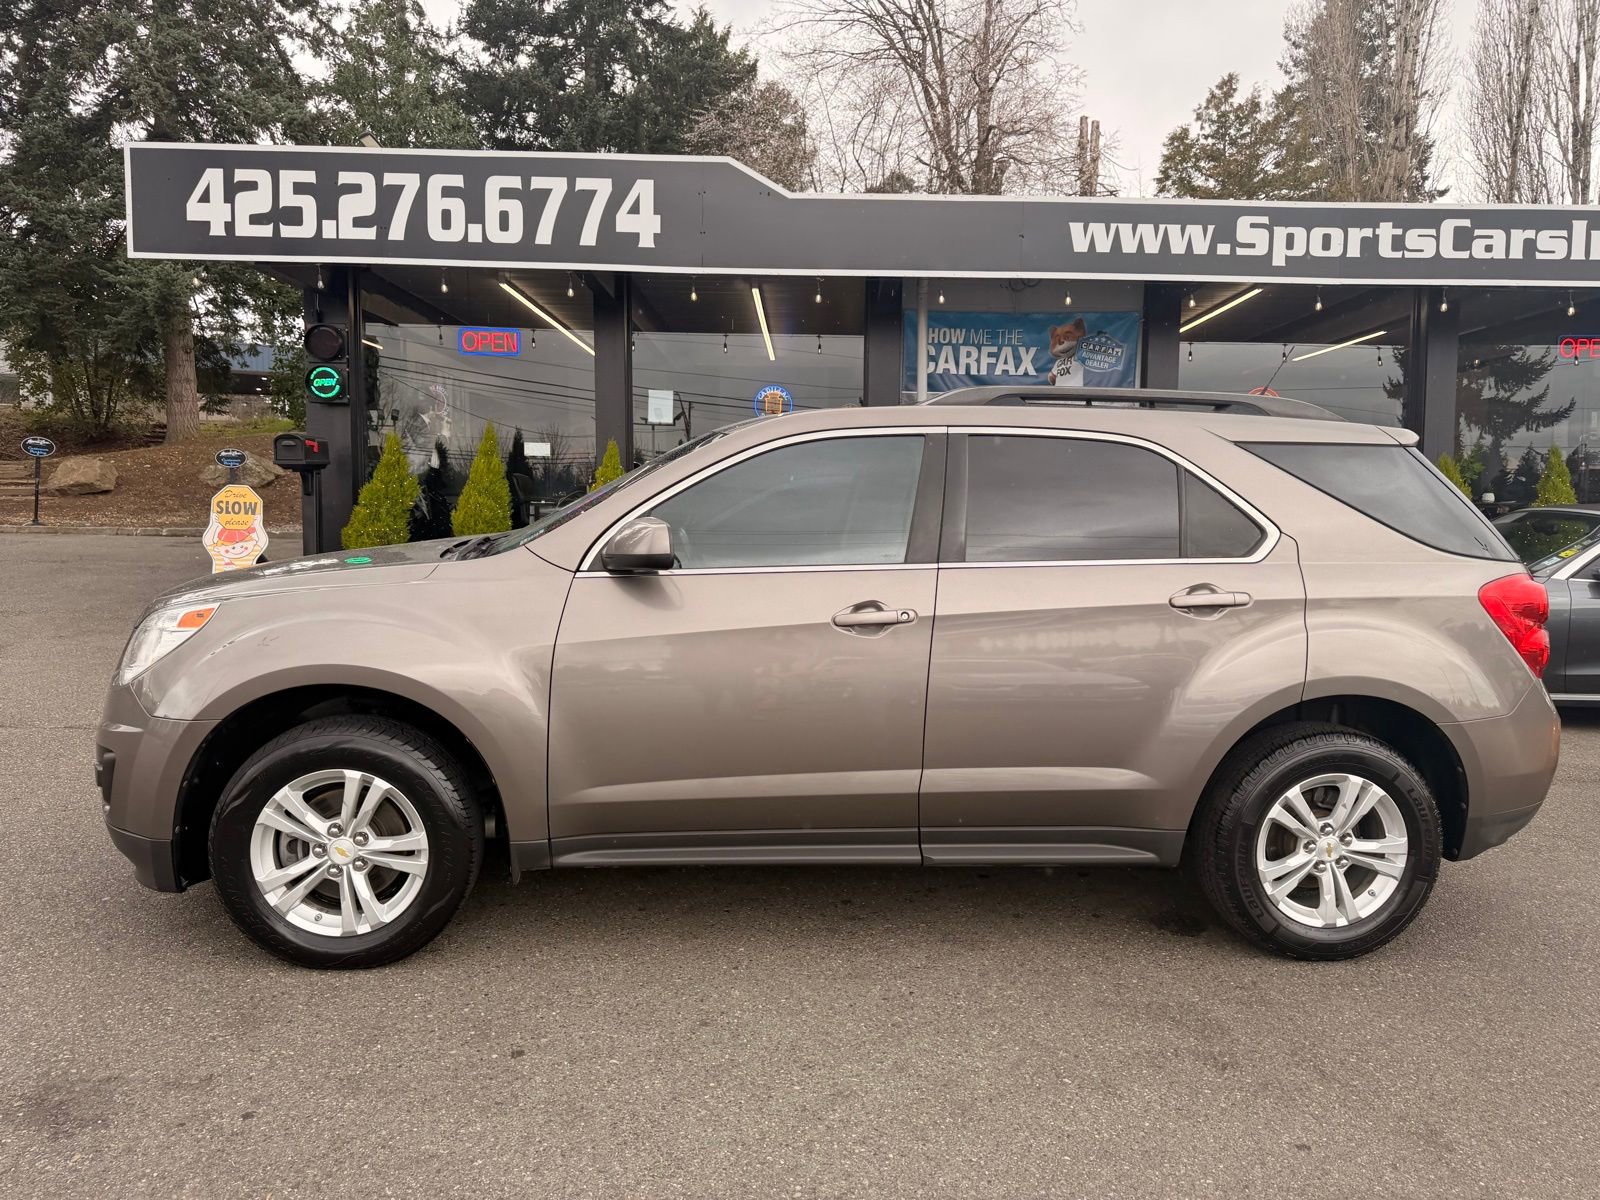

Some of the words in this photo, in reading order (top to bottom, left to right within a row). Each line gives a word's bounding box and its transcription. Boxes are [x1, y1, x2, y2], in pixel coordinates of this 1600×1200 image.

[185, 167, 662, 248] 425.276.6774
[461, 331, 518, 352] OPEN
[928, 327, 967, 344] HOW
[969, 328, 993, 345] ME
[997, 328, 1024, 346] THE
[1081, 342, 1122, 357] CARFAX
[1081, 350, 1118, 364] ADVANTAGE
[1056, 366, 1072, 377] FOX
[1085, 359, 1110, 370] DEALER
[313, 378, 338, 387] OPEN
[225, 490, 247, 499] Drive
[215, 500, 258, 516] SLOW
[225, 517, 249, 526] please
